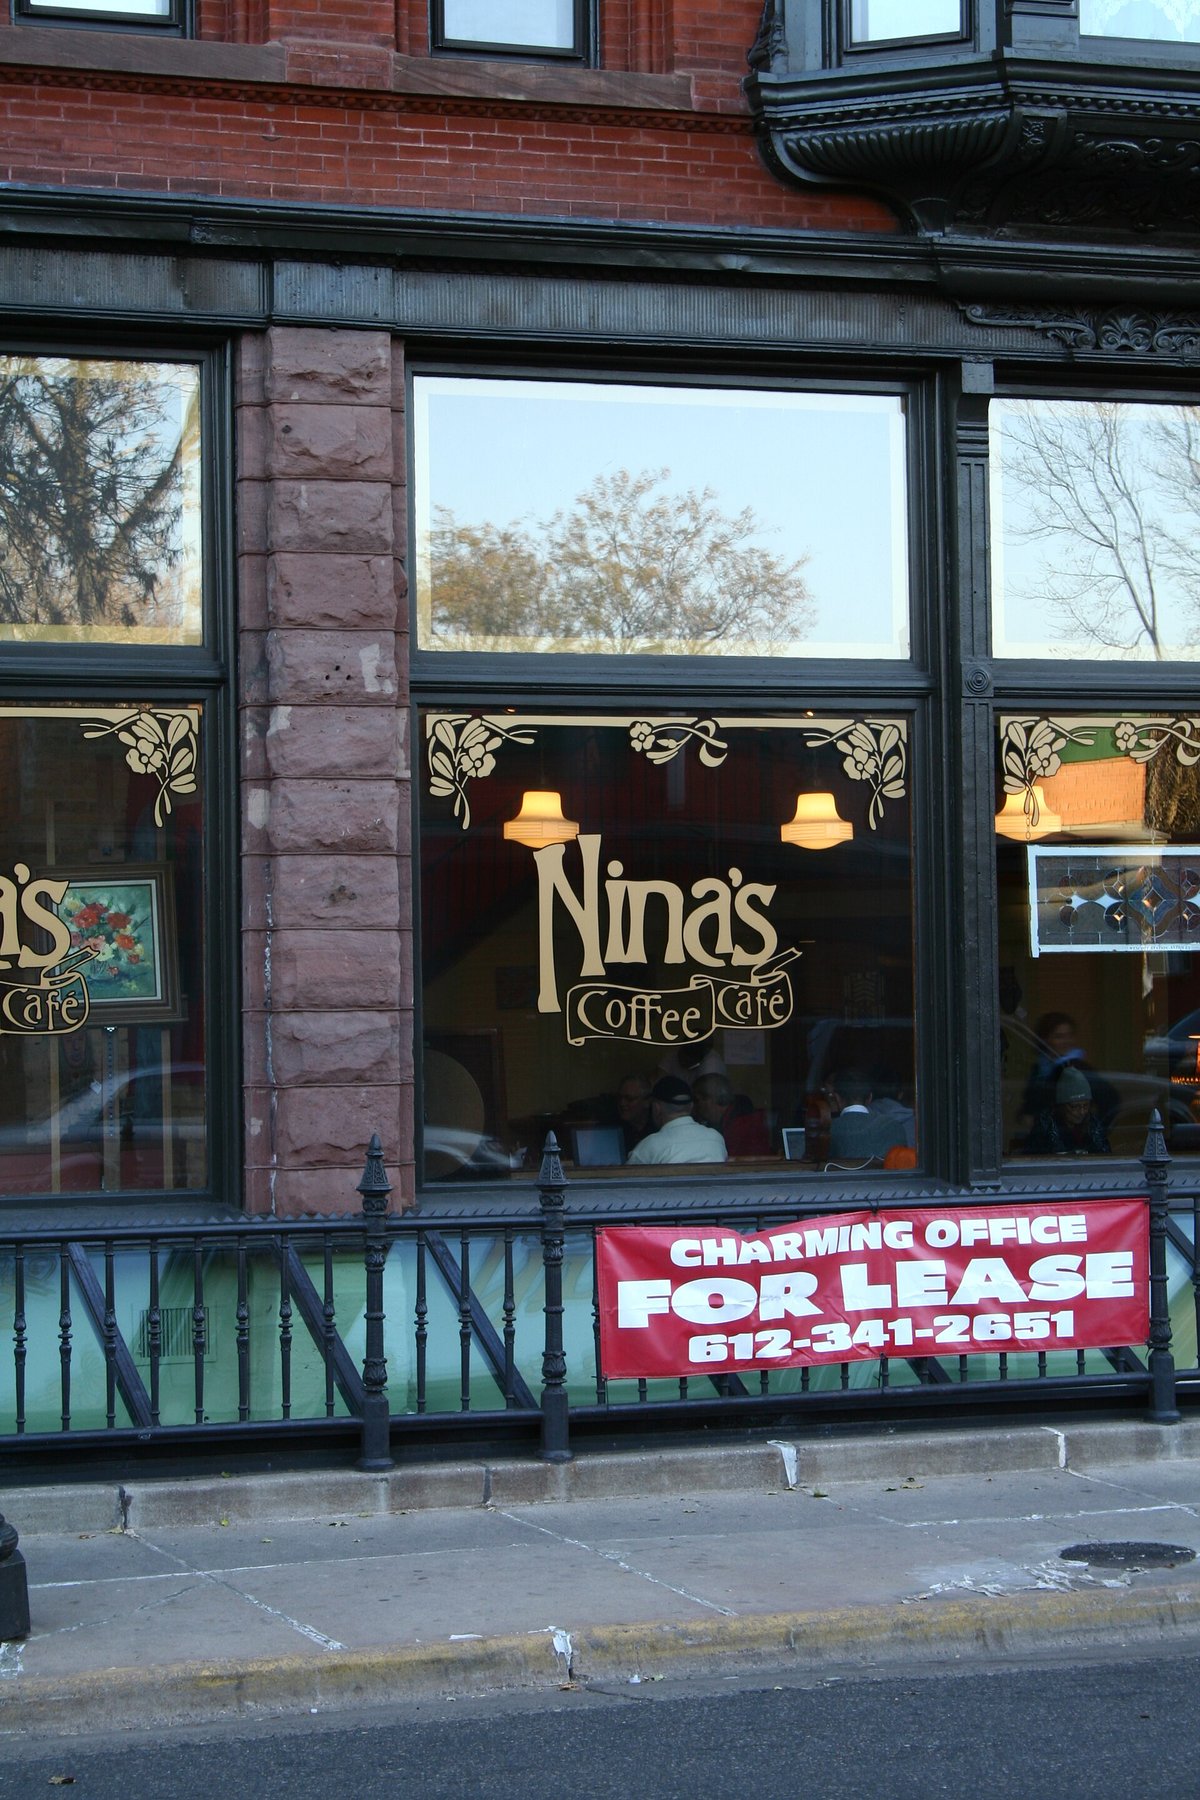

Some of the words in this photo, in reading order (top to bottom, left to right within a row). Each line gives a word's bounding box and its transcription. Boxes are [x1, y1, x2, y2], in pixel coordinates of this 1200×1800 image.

[533, 834, 778, 1013] Nina's
[2, 988, 80, 1030] Café
[577, 990, 700, 1040] Coffee
[717, 985, 784, 1025] Café
[669, 1221, 914, 1268] CHARMING
[925, 1214, 1088, 1248] OFFICE
[617, 1271, 824, 1329] FOR
[839, 1251, 1135, 1312] LEASE
[688, 1309, 1075, 1363] 612-341-2651
